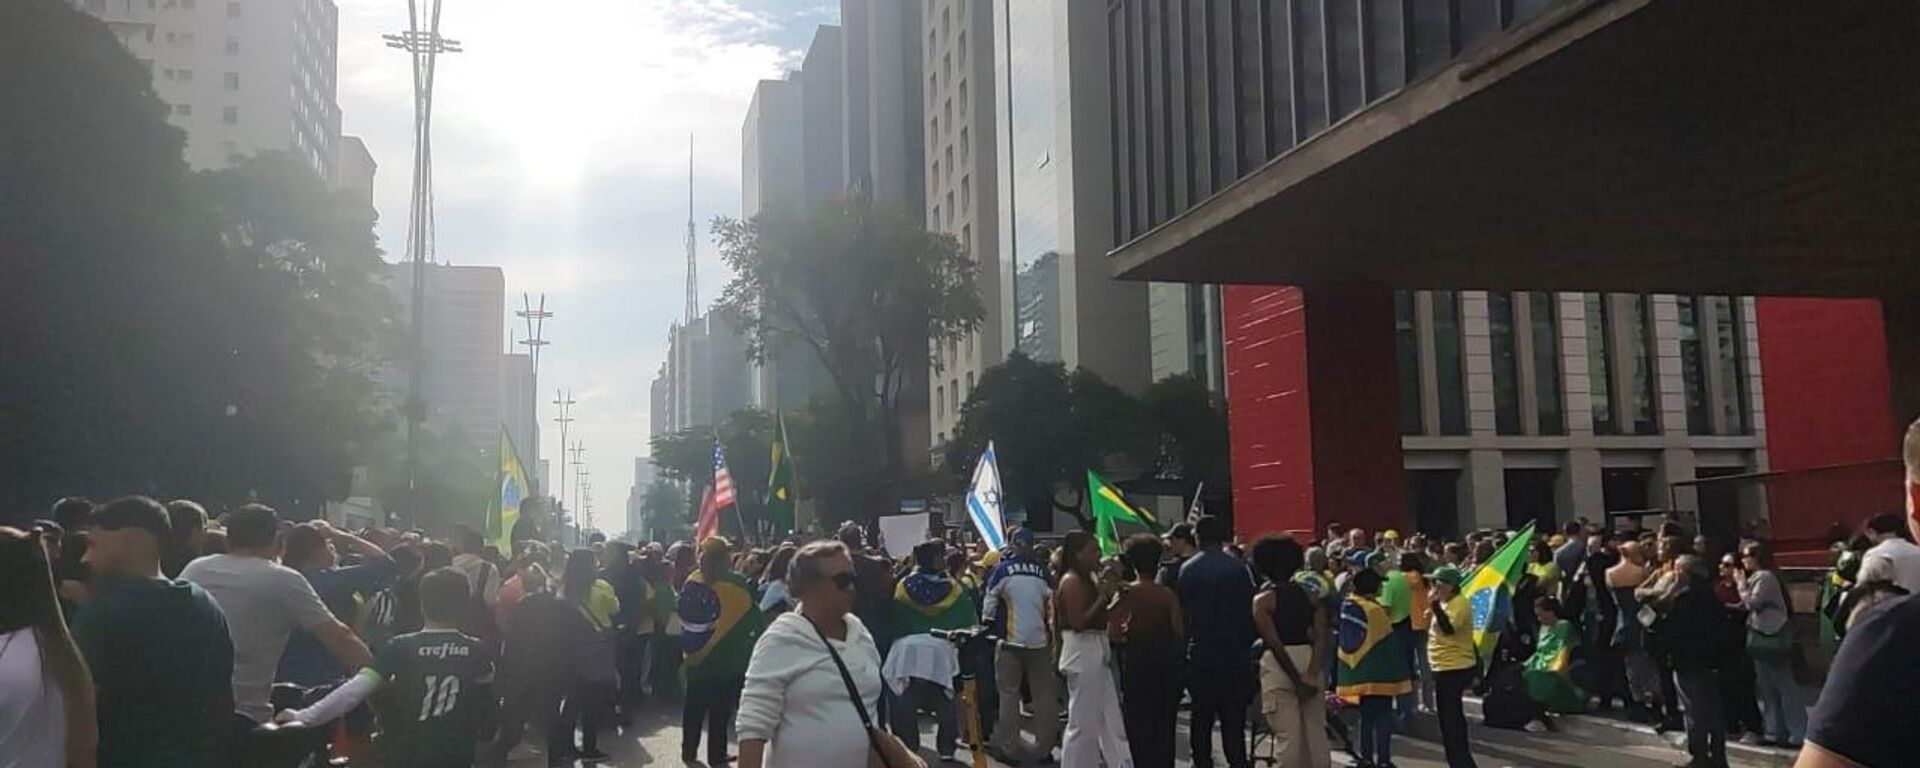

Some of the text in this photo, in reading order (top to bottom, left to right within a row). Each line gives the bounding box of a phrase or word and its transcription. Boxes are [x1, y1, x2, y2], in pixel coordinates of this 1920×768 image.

[1007, 563, 1044, 577] BRASIL
[418, 642, 469, 659] crefisa
[418, 675, 459, 721] 10
